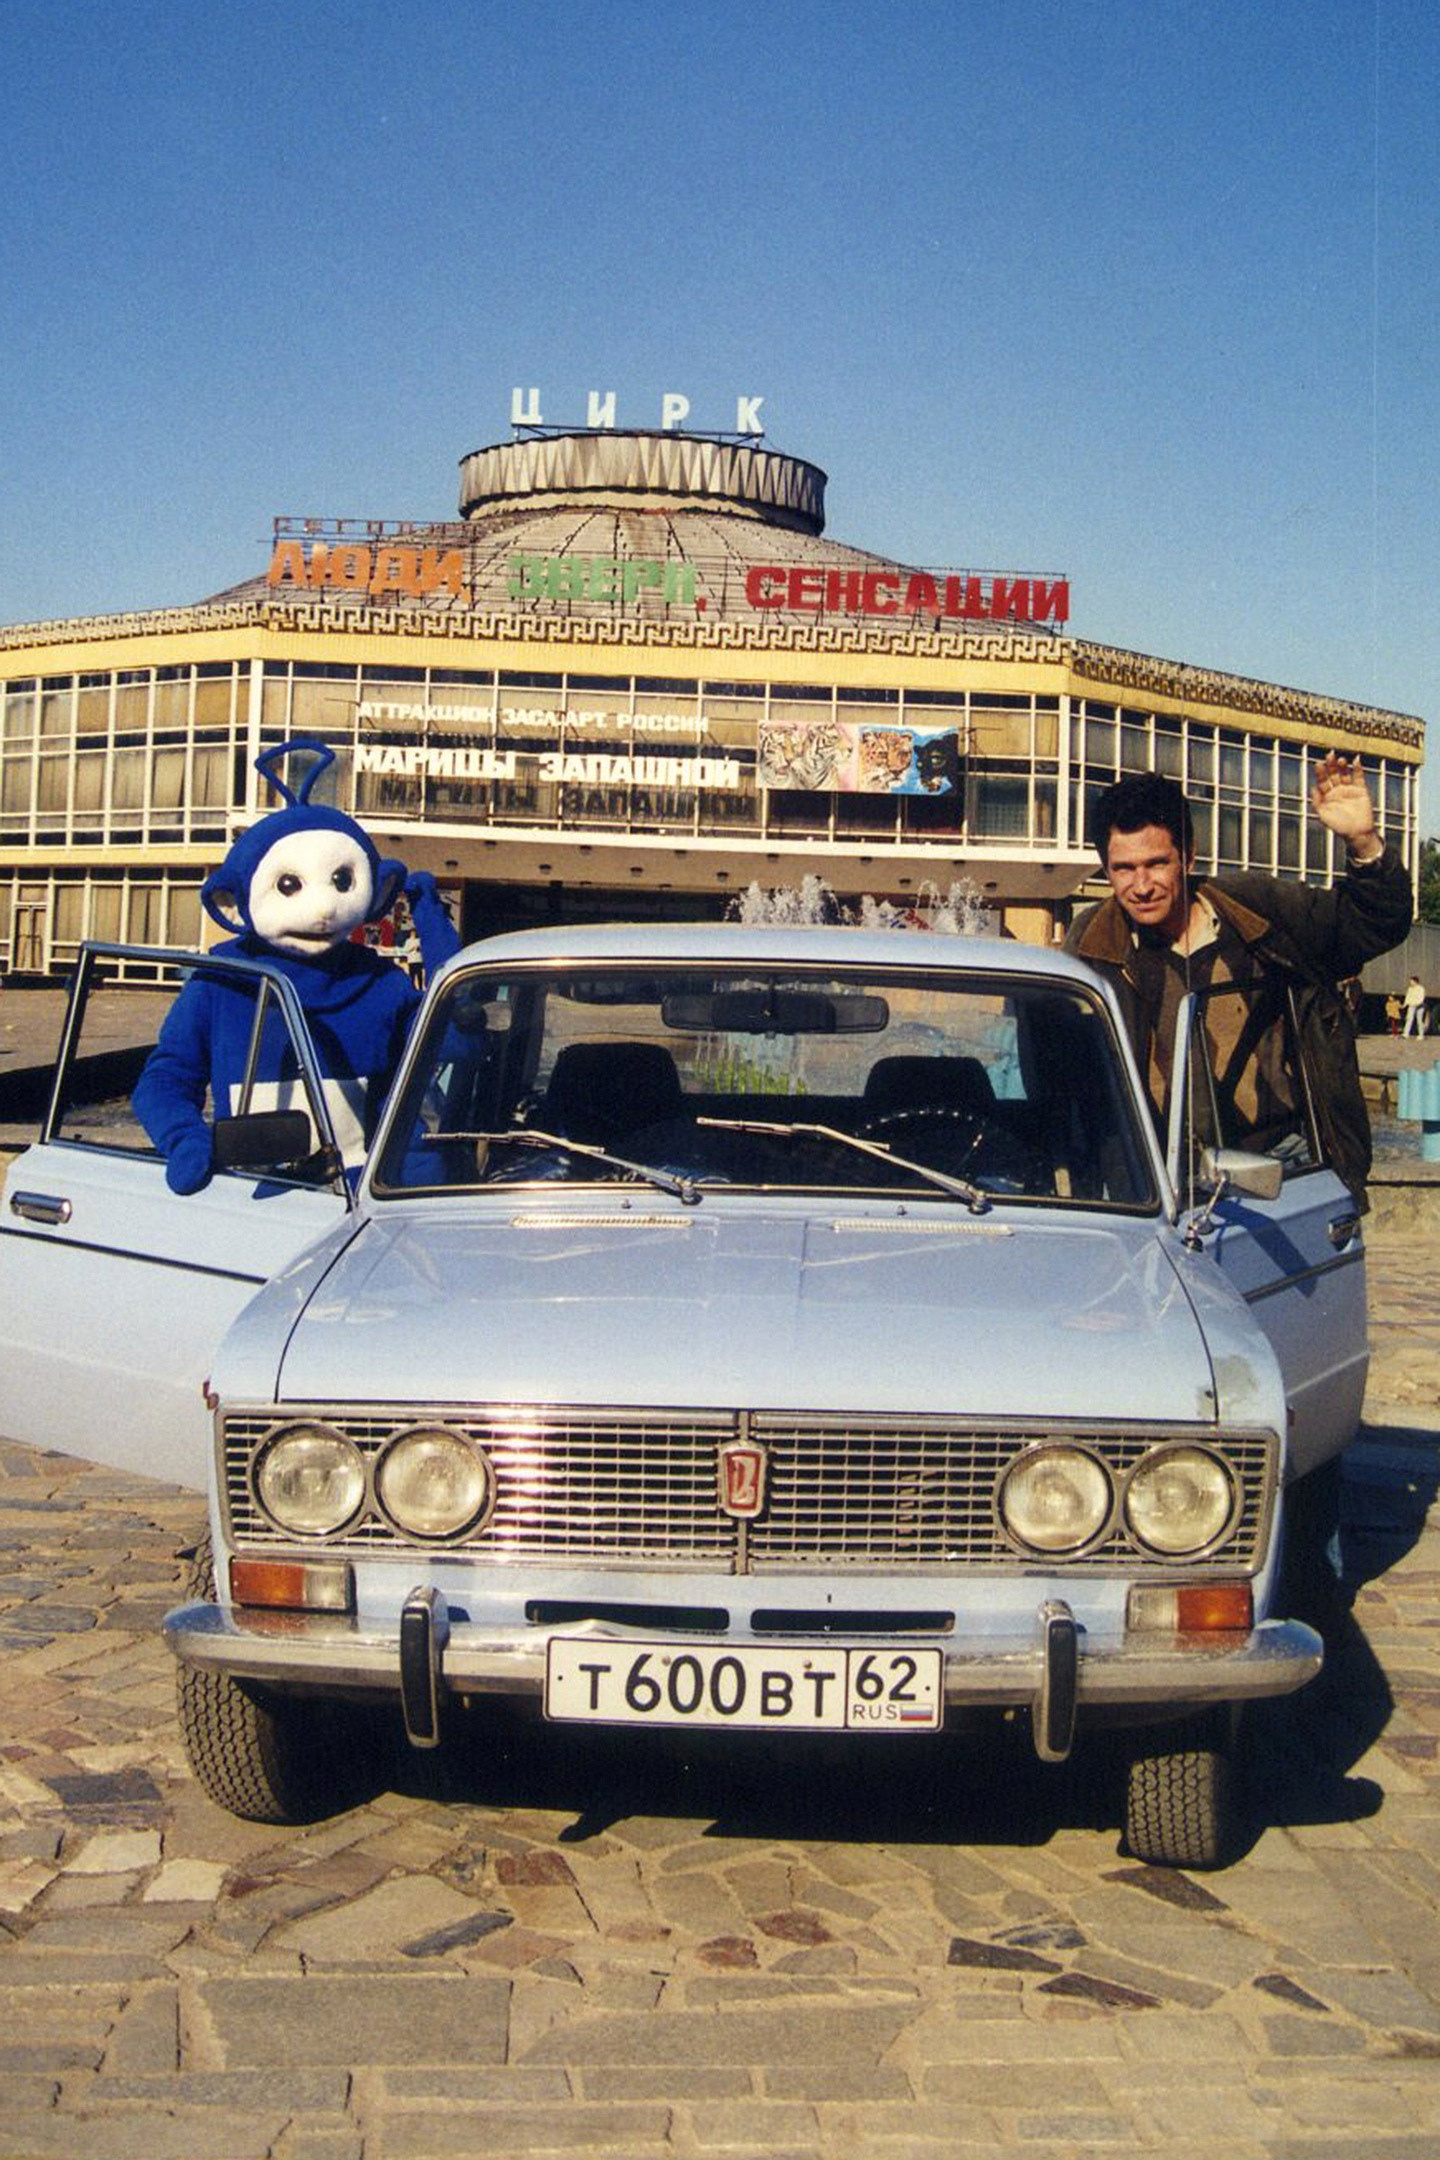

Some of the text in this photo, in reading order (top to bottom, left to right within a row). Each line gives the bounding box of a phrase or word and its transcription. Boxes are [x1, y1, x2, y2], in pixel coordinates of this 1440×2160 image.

[511, 387, 765, 435] ЦИРК
[745, 566, 1070, 622] СЕНСАЦИИ
[359, 701, 496, 723] АТТРАКЦИОН
[616, 713, 709, 733] РОССИИ
[357, 745, 741, 789] МАРИЦЫ ЗАПАШНОЙ
[856, 1654, 917, 1701] 62
[852, 1703, 898, 1720] RUS
